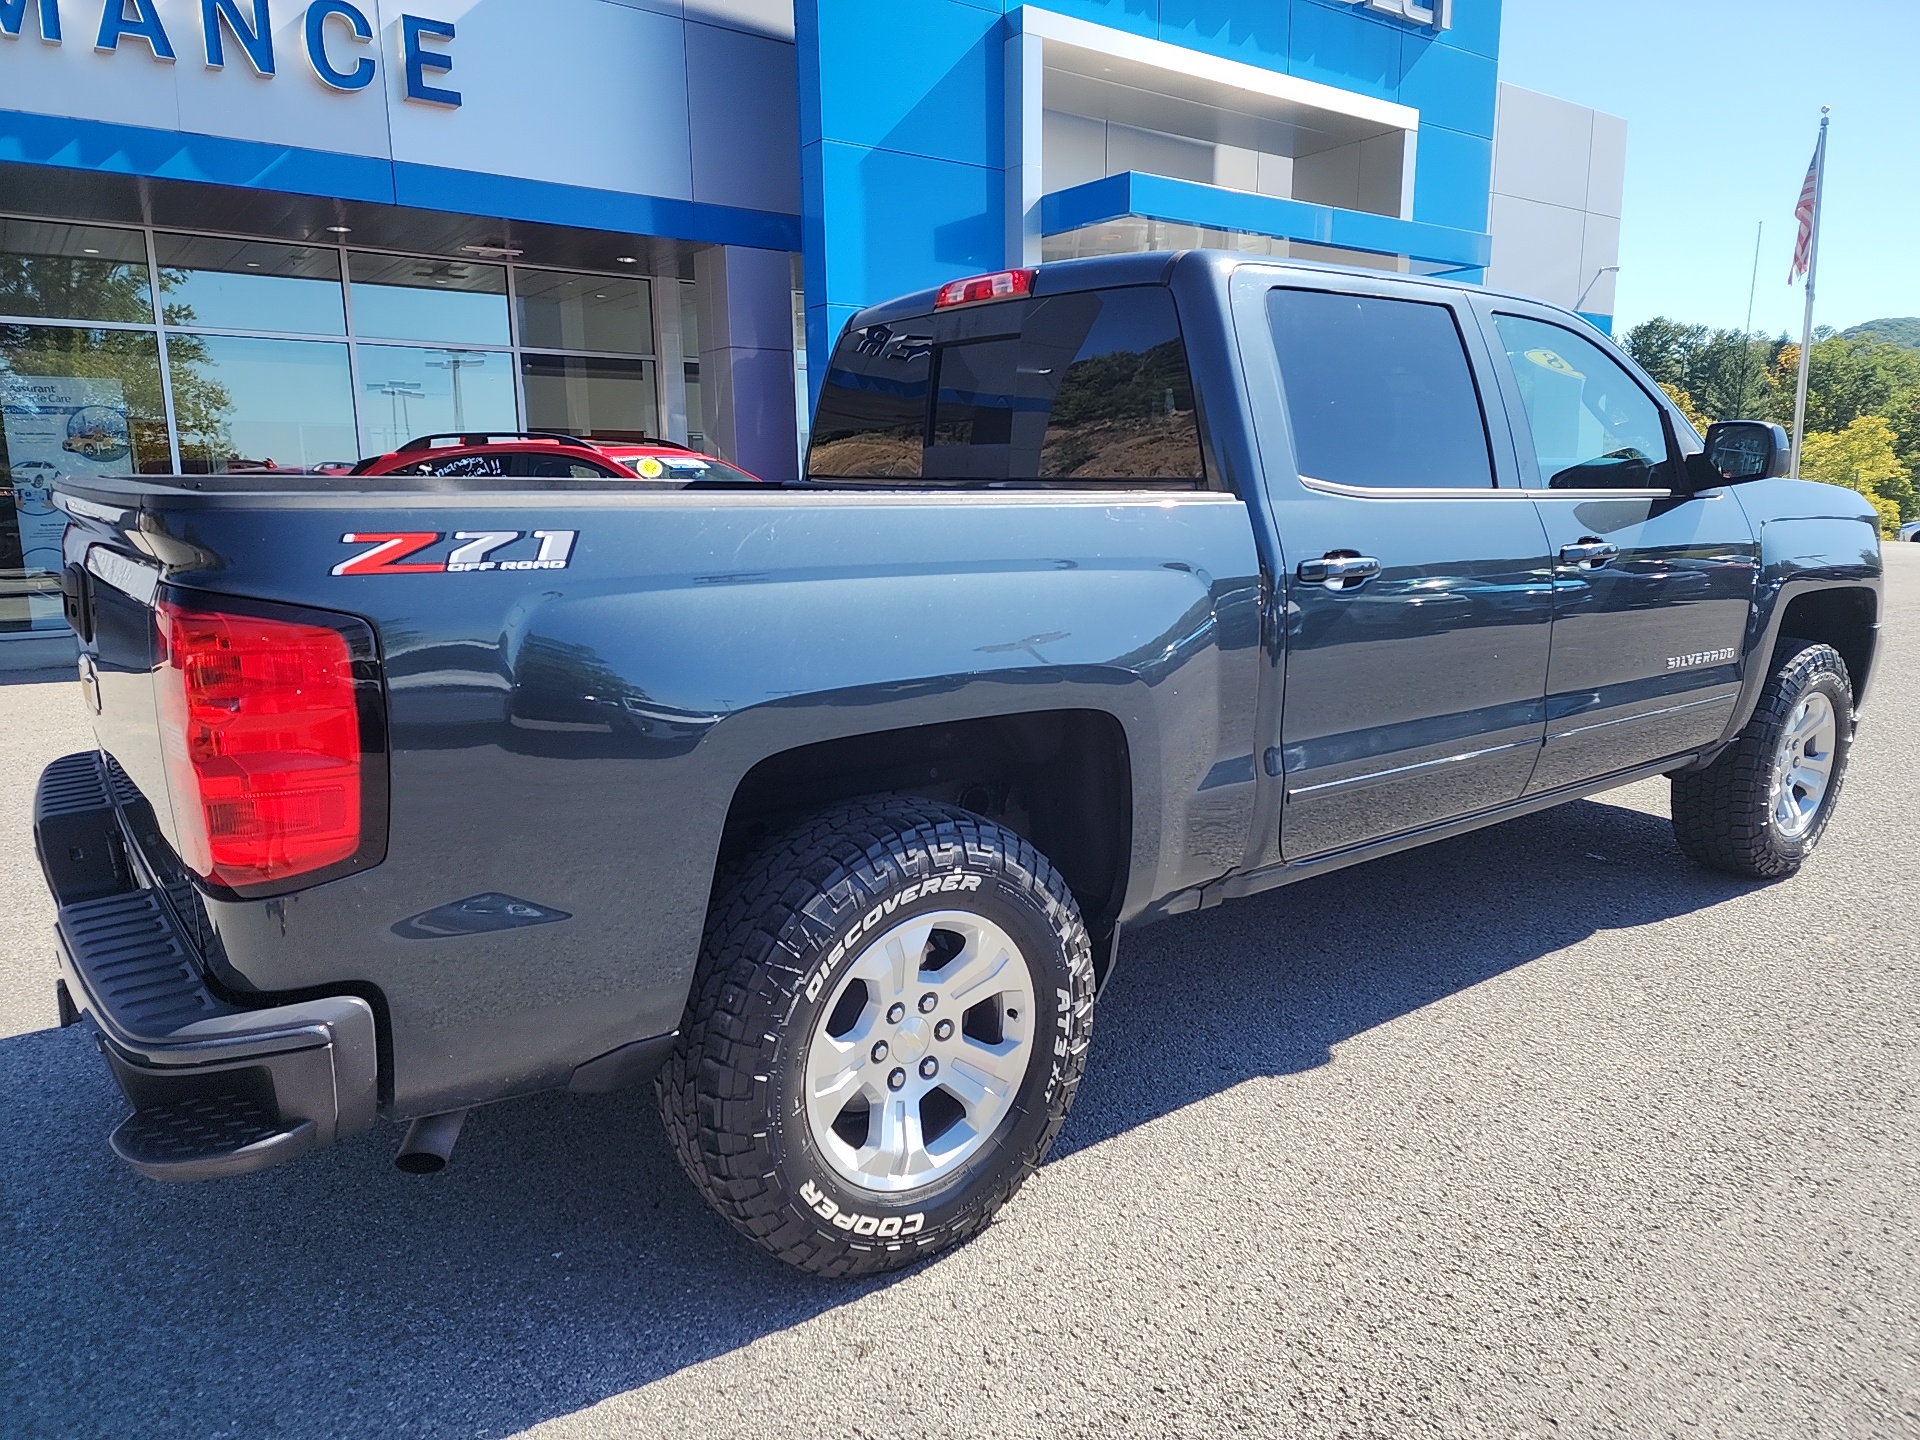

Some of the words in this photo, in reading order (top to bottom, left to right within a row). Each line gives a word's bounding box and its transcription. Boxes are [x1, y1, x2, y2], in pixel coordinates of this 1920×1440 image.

[48, 394, 72, 403] Care
[330, 530, 578, 576] Z71
[447, 562, 496, 572] OFF
[500, 560, 567, 571] ROAD
[1666, 647, 1735, 670] SILVERADO
[805, 875, 982, 1003] DISCOVERER
[1054, 987, 1071, 1057] AT3
[799, 1178, 925, 1237] COOPER
